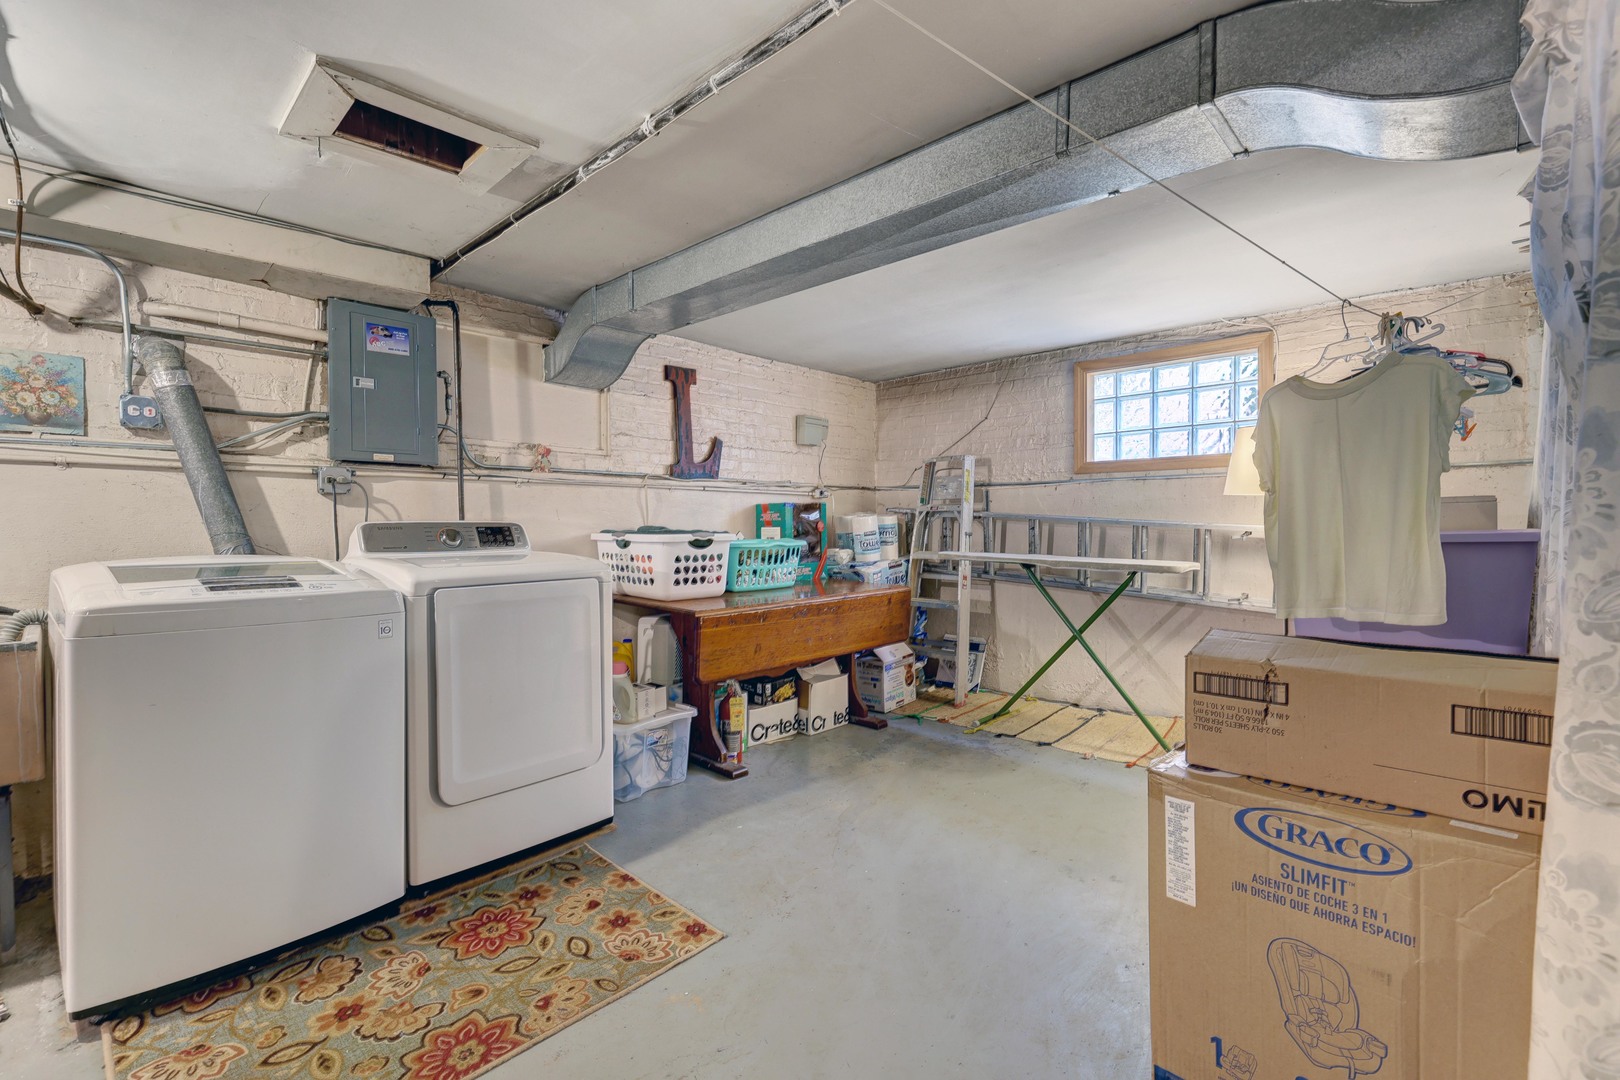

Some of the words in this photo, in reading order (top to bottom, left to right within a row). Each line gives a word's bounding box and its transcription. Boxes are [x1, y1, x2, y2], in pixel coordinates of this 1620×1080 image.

[664, 365, 723, 480] L
[1205, 701, 1218, 710] 10.1
[1194, 715, 1210, 723] ROLL
[1211, 718, 1223, 726] PER
[1193, 723, 1213, 732] ROLLS
[1225, 720, 1250, 730] SHEETS
[1251, 725, 1270, 734] 2-PLY
[1252, 873, 1293, 894] ASIENTO
[1297, 887, 1310, 900] DE
[1313, 892, 1348, 911] COCHE
[1352, 903, 1359, 915] 3
[1363, 906, 1377, 921] EN
[1382, 912, 1388, 924] 1
[1231, 880, 1247, 893] ¡UN
[1251, 886, 1286, 906] DISEÑO
[1290, 898, 1310, 914] QUE
[1313, 906, 1358, 930] AHORRA
[1362, 921, 1416, 947] ESPACIO!
[1210, 1036, 1223, 1069] 1
